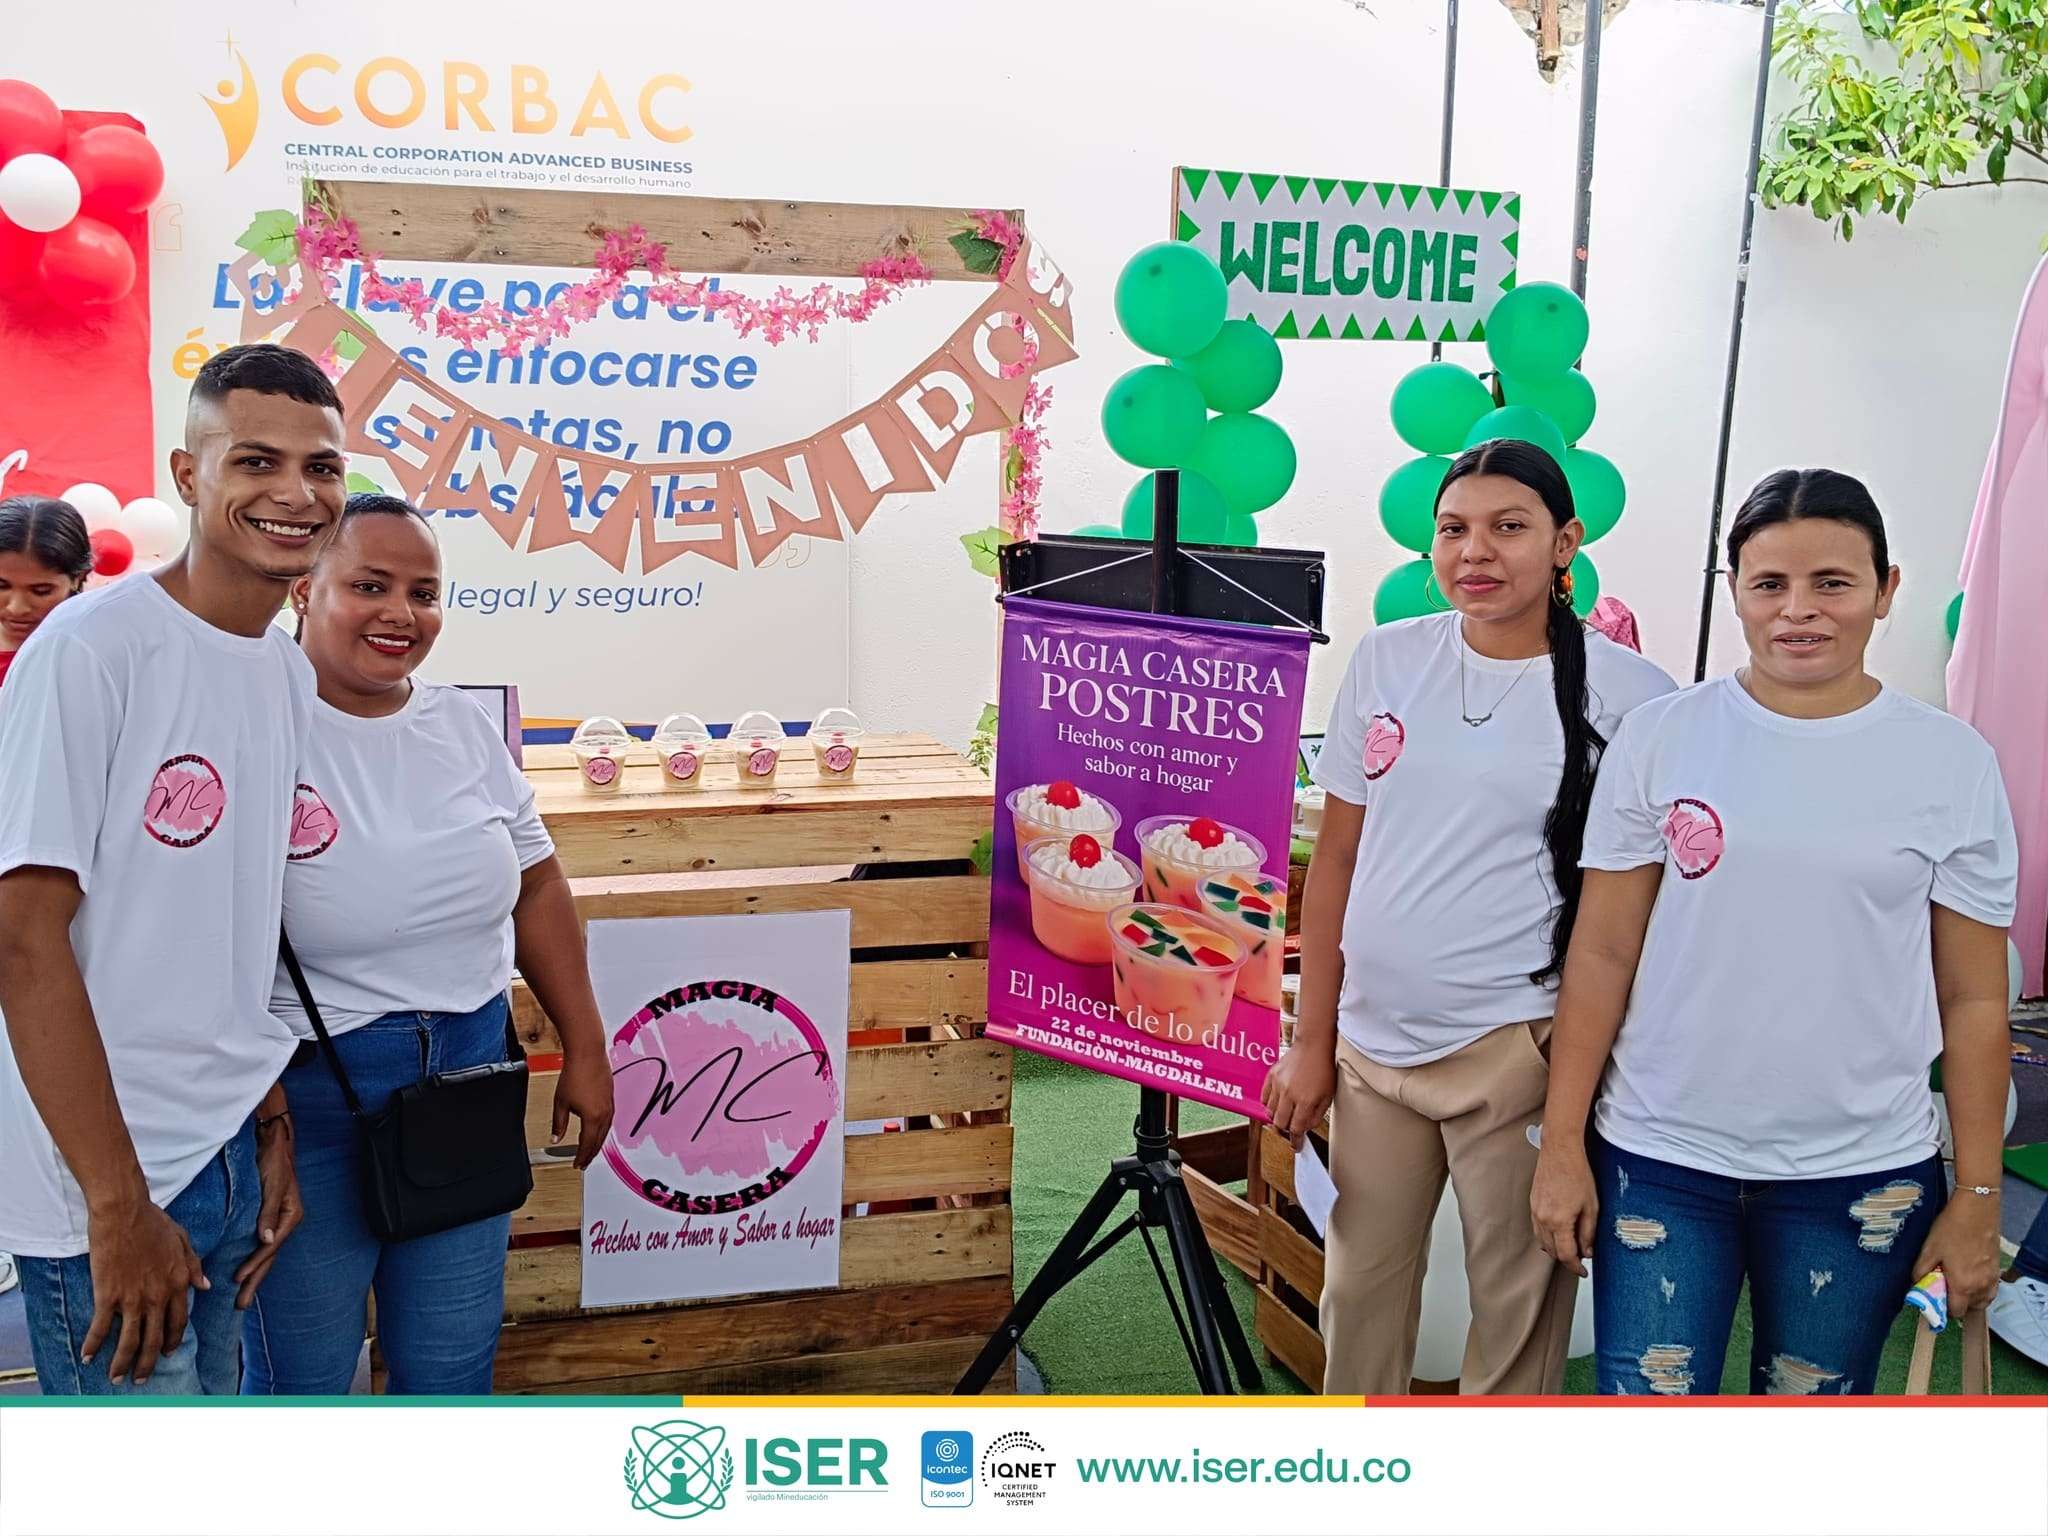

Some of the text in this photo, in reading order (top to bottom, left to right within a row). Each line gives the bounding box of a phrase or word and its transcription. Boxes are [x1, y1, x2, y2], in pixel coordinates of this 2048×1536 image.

[281, 53, 695, 143] CORBAC
[284, 143, 693, 174] CENTRAL CORPORATION ADVANCED BUSINESS
[286, 161, 692, 189] Institución de educación para el trabajo y el desarrollo humano
[1219, 221, 1478, 303] WELCOME
[446, 337, 757, 391] enfocarse
[657, 418, 732, 455] no
[447, 581, 703, 614] legal y seguro!
[1021, 633, 1287, 698] MAGIA CASERA
[1038, 672, 1264, 744] POSTRES
[1057, 722, 1239, 776] Hechos con amor y
[1085, 753, 1214, 793] sabor a hogar
[646, 979, 780, 1019] MAGIA
[1008, 969, 1276, 1065] El placer de lo dulce
[1050, 1016, 1204, 1070] 22 de noviembre
[612, 1046, 828, 1143] MC
[641, 1165, 797, 1214] CASERA
[589, 1206, 835, 1255] Hechos con Amor y Sabor a hogar
